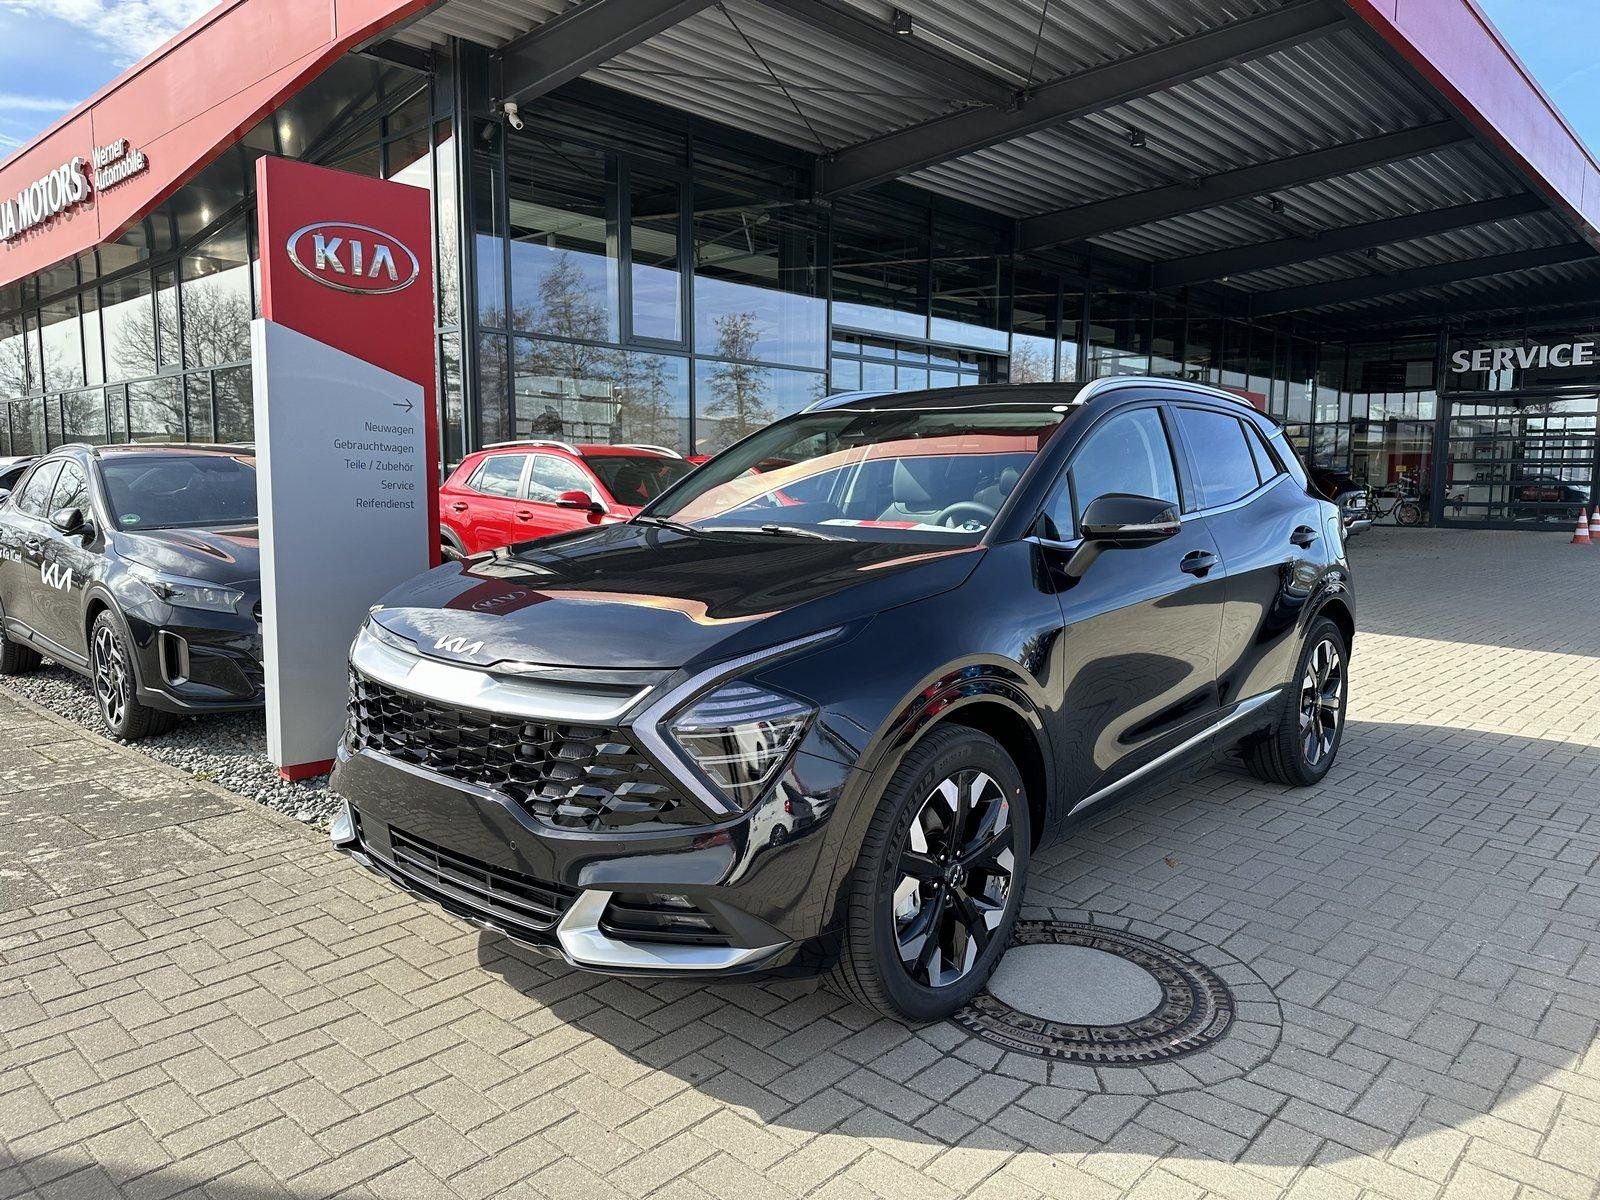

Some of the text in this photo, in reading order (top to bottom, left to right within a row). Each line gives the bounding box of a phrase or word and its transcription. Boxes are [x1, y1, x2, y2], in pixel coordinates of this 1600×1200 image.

[92, 138, 125, 168] Werner
[94, 149, 145, 191] Automobile
[0, 157, 84, 239] IA MOTORS
[312, 233, 399, 281] KIA
[1451, 342, 1595, 373] SERVICE
[364, 421, 414, 436] Neuwagen
[333, 439, 414, 455] Gebrauchtwagen
[344, 458, 367, 470] Teile
[375, 460, 414, 472] Zubehör
[380, 479, 415, 491] Service
[356, 498, 415, 510] Reifendienst
[41, 559, 74, 594] KIA
[433, 635, 485, 656] KIA
